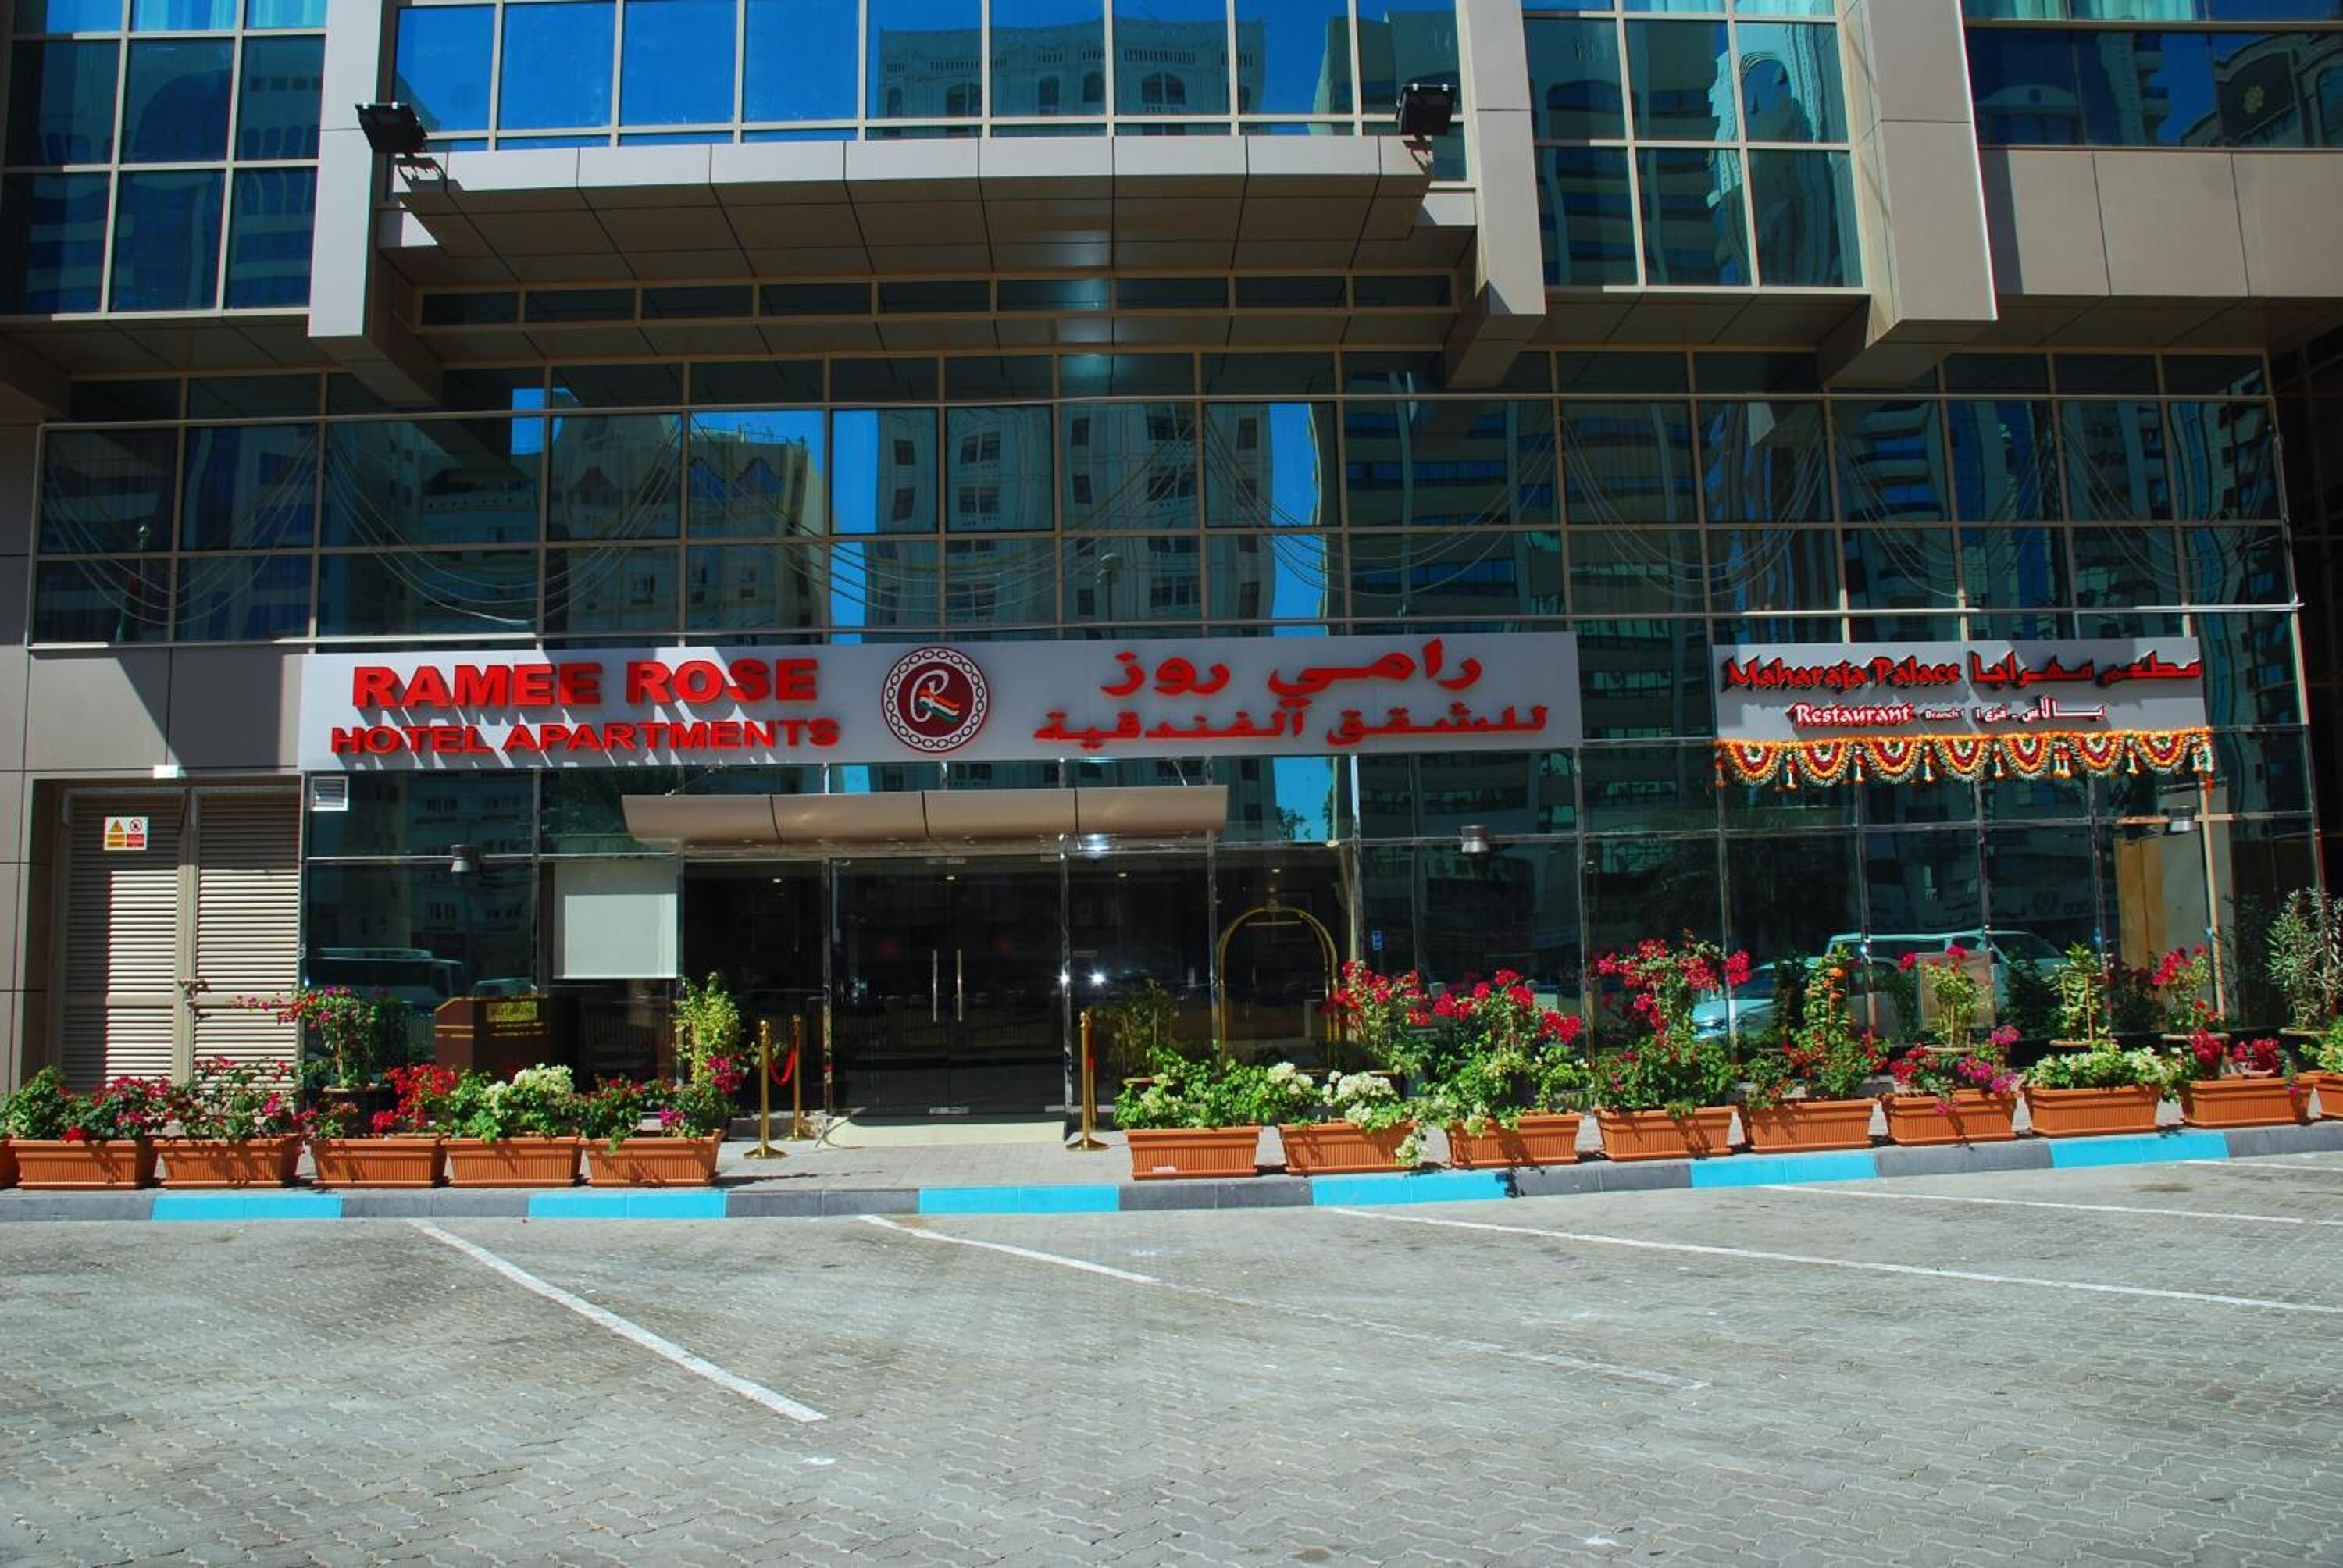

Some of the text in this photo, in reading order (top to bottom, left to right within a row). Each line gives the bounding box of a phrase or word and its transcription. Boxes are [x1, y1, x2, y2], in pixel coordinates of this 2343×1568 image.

[351, 657, 819, 707] RAMEE ROSE
[1100, 651, 1232, 696] روز
[1724, 655, 1961, 692] Maharaja Palace
[2099, 650, 2202, 686] مطعم
[1032, 701, 1548, 750] للشقق الفندقية
[1795, 704, 1913, 726] Restaurant
[330, 717, 840, 754] HOTEL APARTMENTS
